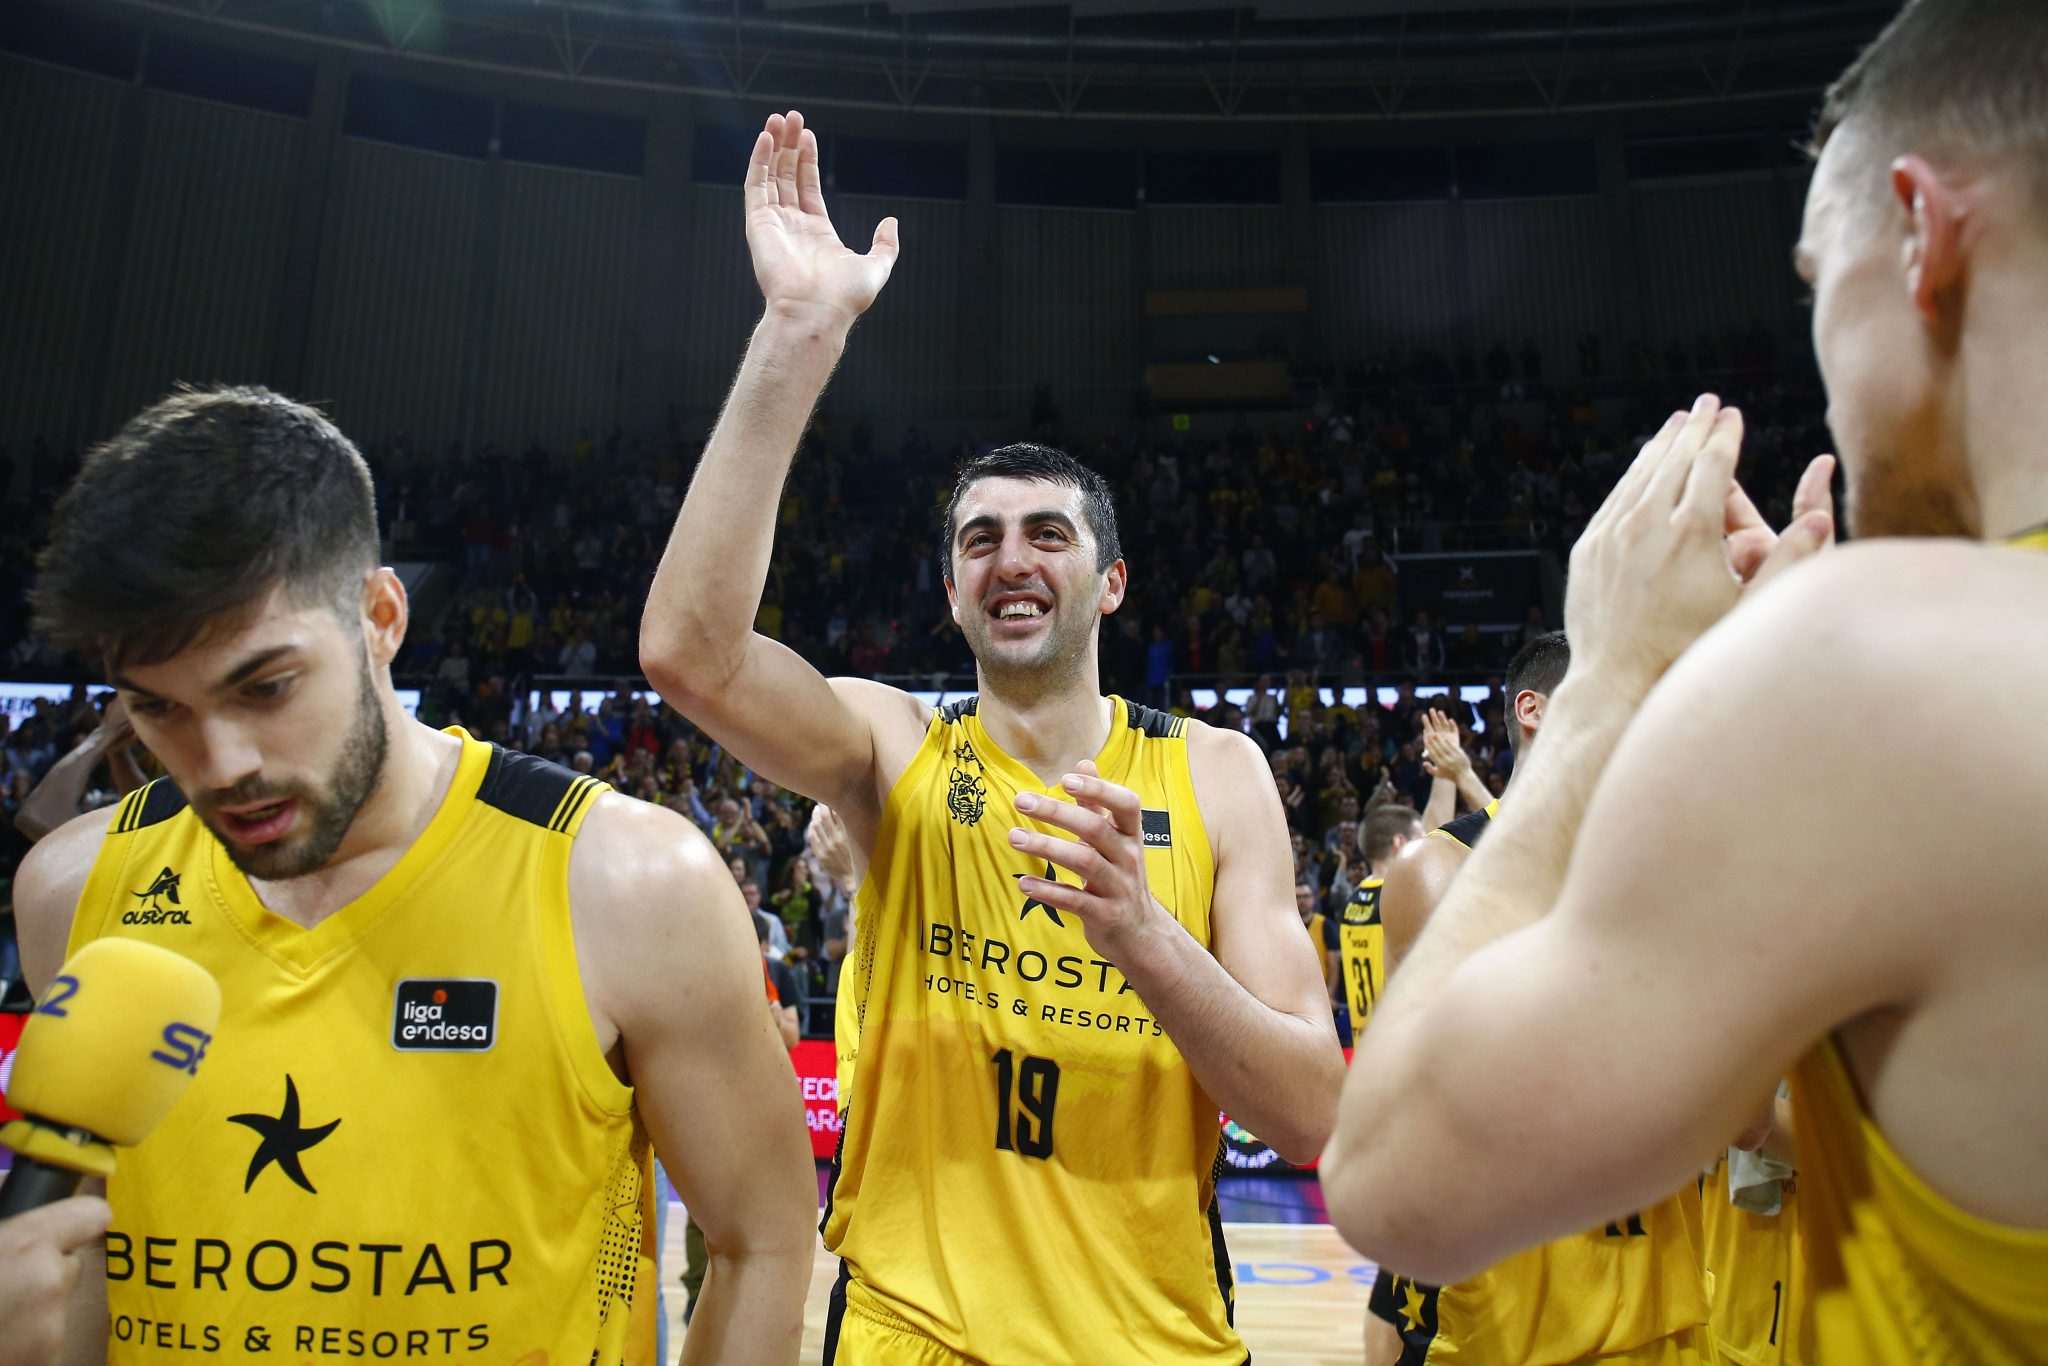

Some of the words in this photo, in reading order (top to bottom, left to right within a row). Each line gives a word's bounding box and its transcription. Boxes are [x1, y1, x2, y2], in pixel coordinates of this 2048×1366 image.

[122, 910, 192, 925] austral
[402, 1021, 488, 1041] endesa
[403, 1001, 442, 1023] liga
[1012, 999, 1028, 1017] &
[1041, 1005, 1163, 1037] RESORTS
[991, 1048, 1060, 1161] 19
[106, 1231, 512, 1297] BEROSTAR
[109, 1312, 221, 1352] OTELS
[244, 1326, 271, 1352] &
[296, 1324, 489, 1358] RESORTS
